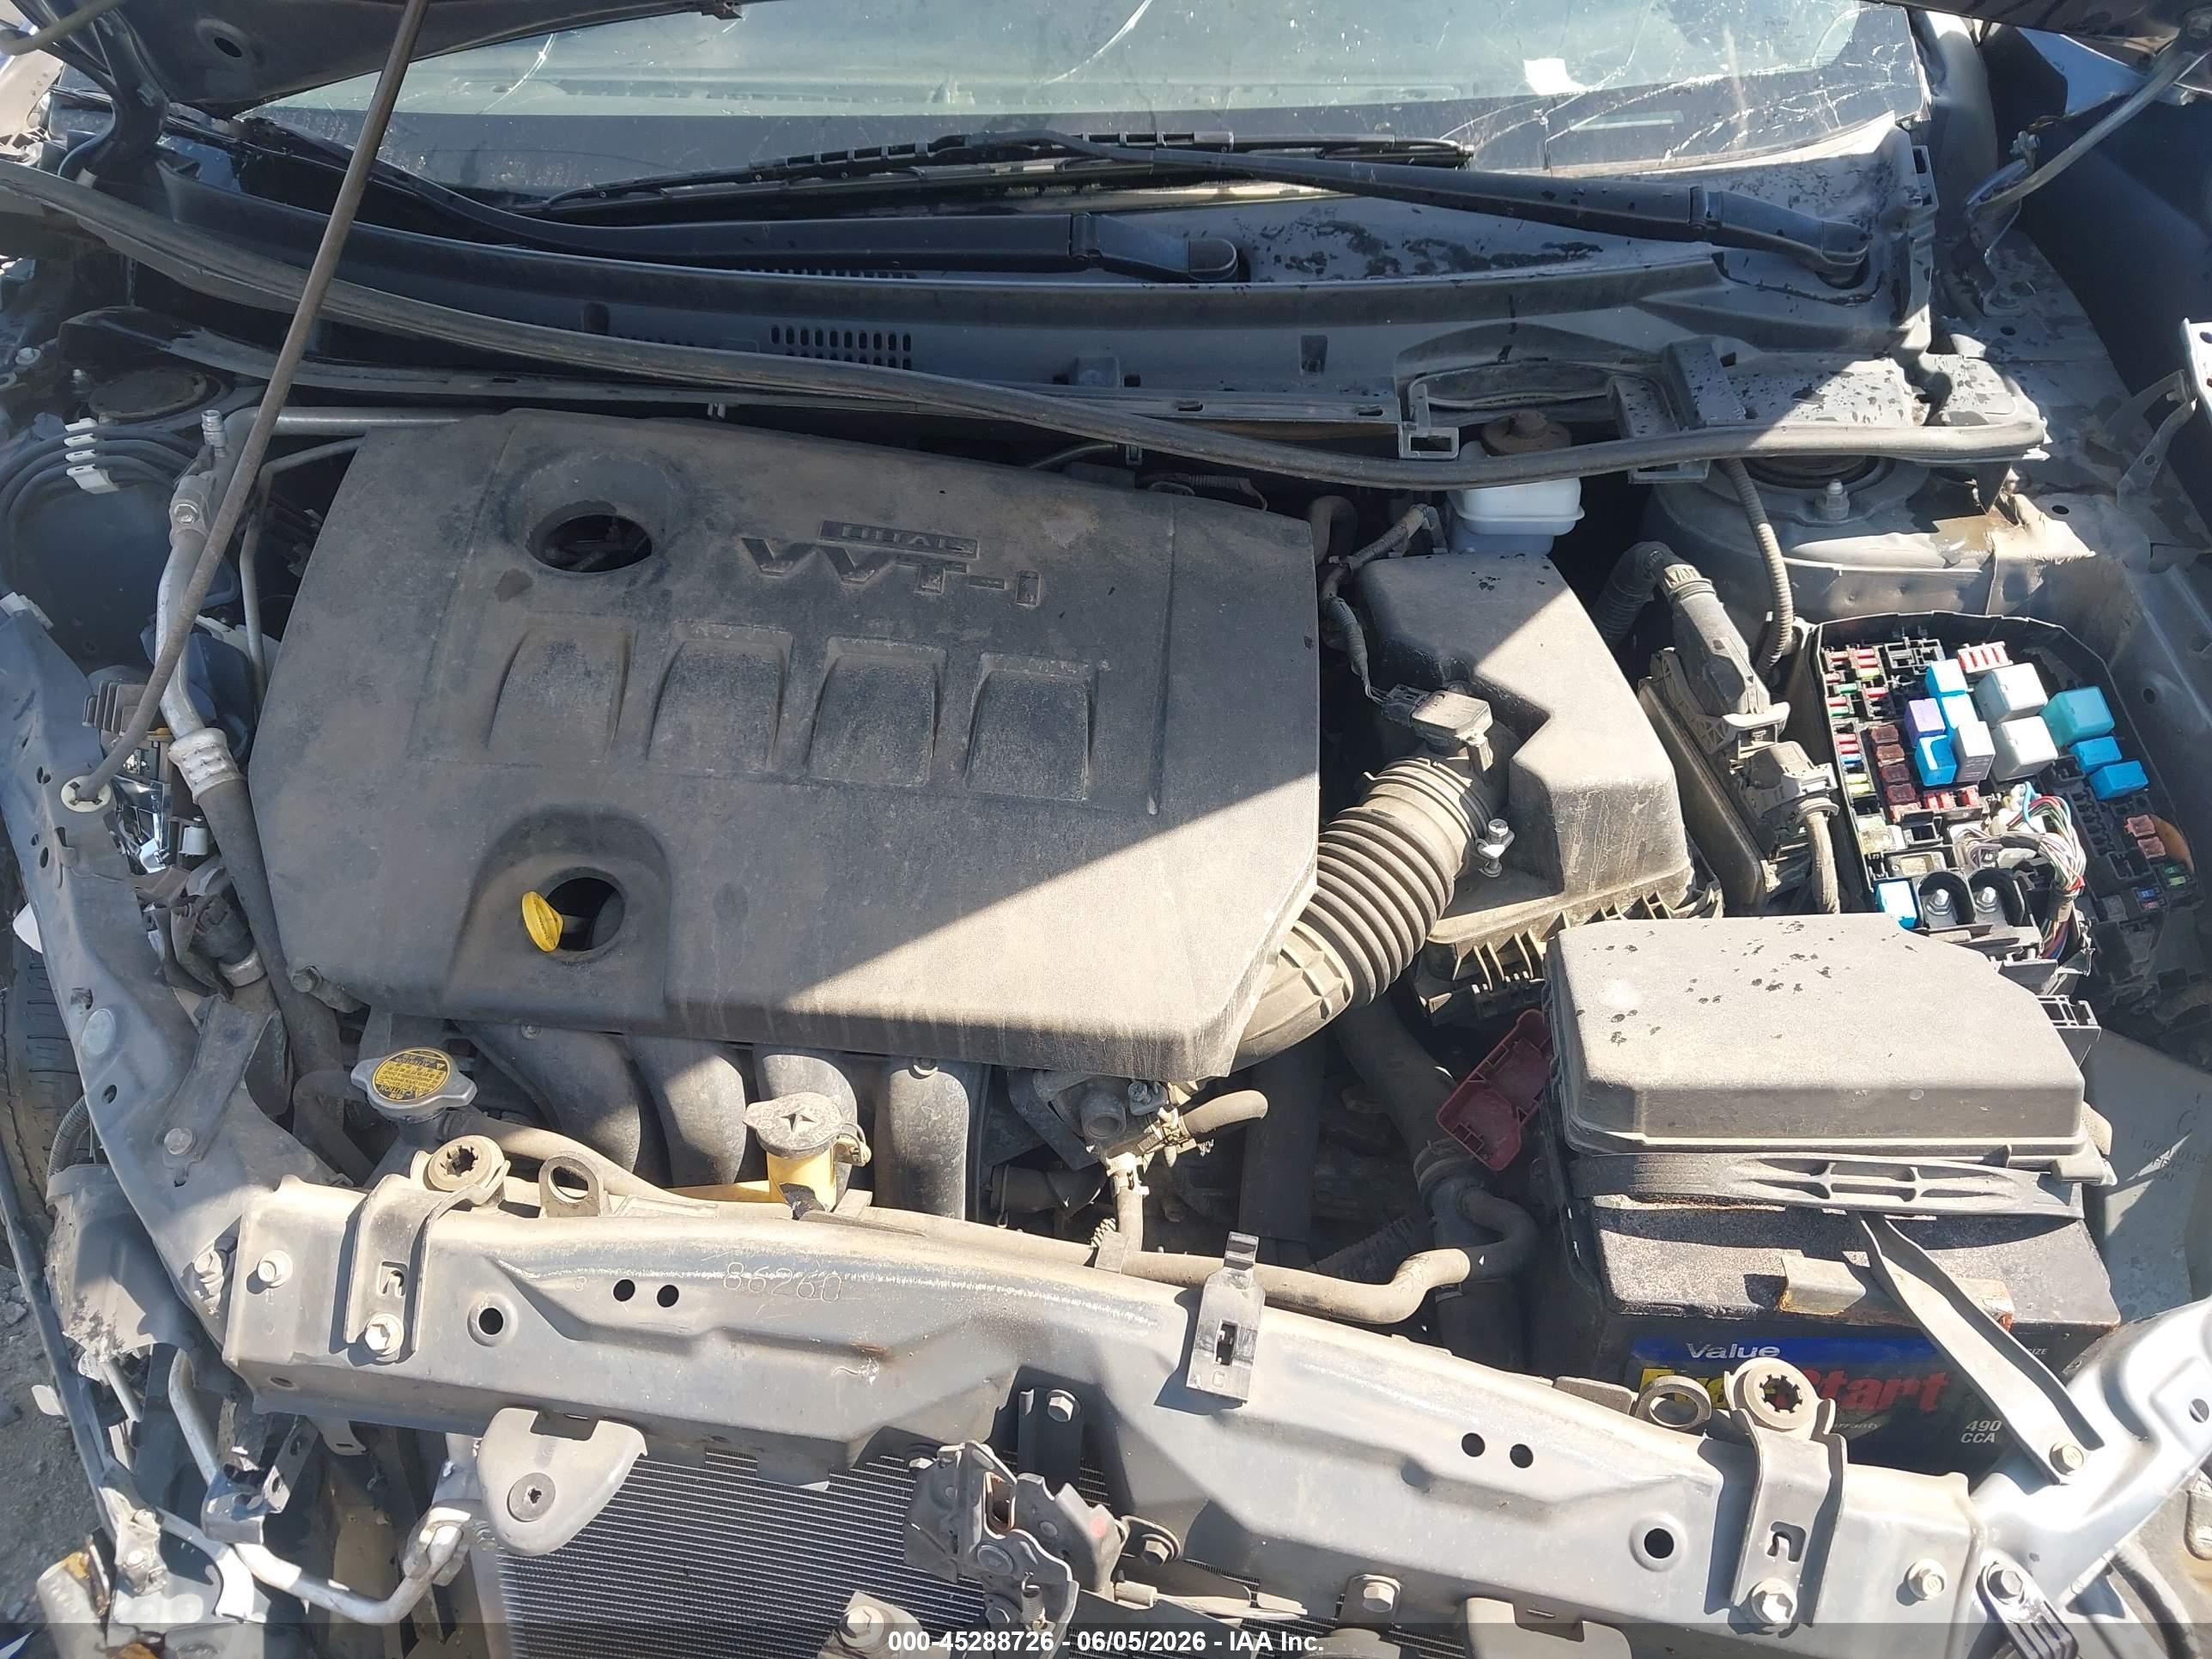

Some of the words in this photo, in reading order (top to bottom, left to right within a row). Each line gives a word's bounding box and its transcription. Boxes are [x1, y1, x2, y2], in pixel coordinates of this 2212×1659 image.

[378, 1085, 414, 1097] CAUTION
[1686, 1343, 1780, 1359] Value
[1965, 1419, 2002, 1431] 490
[1960, 1431, 1996, 1443] CCA
